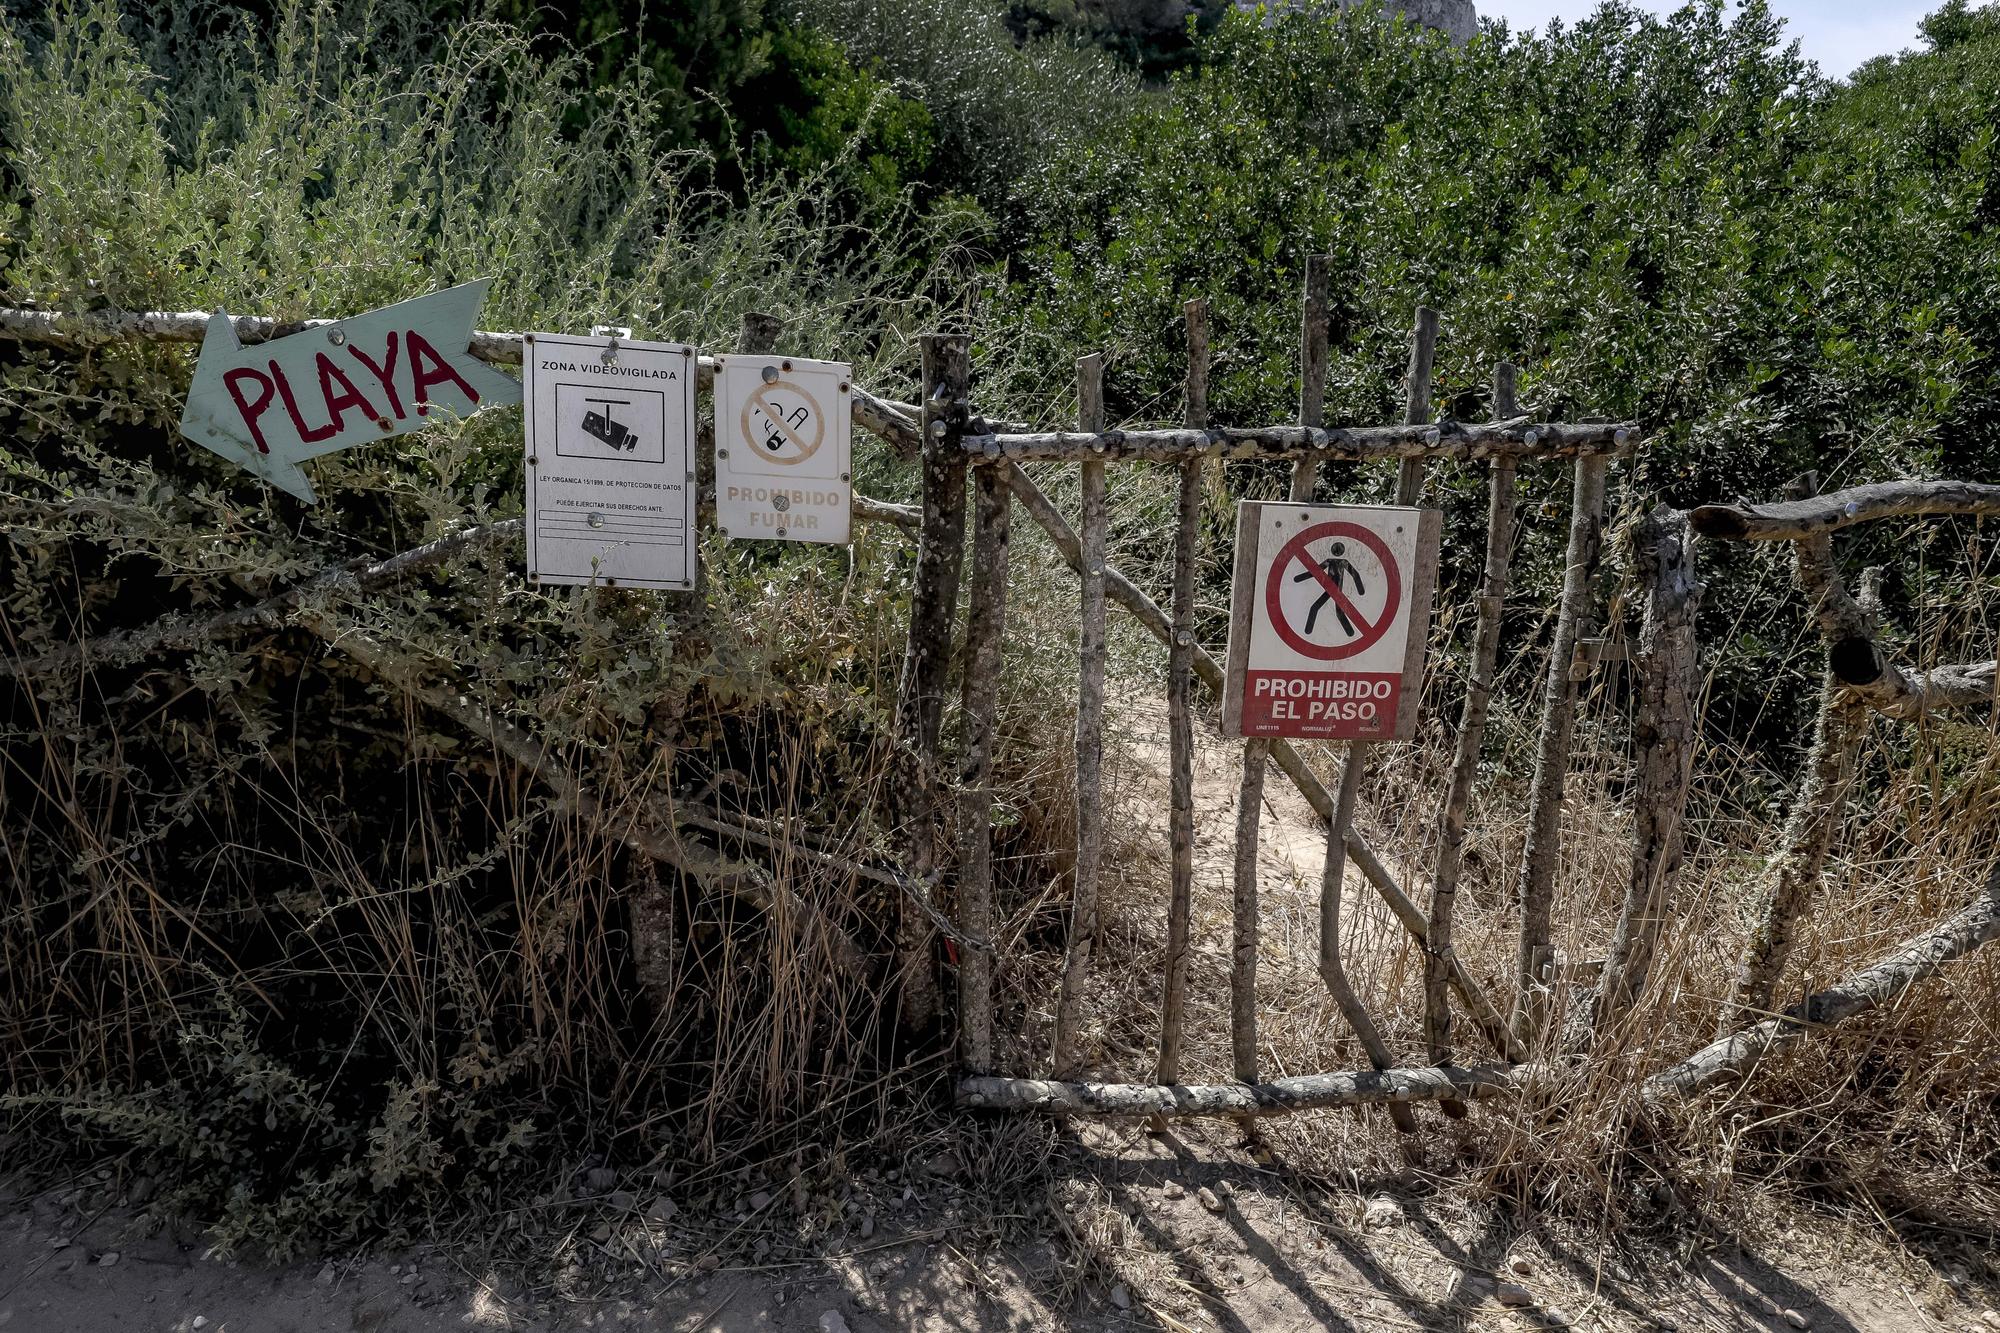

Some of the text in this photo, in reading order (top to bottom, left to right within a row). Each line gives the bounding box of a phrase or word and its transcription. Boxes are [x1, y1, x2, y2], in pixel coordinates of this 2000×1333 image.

[541, 361, 677, 381] ZONA VIDEOVIGILADA
[223, 329, 480, 454] PLAYA
[615, 480, 653, 489] PROTECCION
[556, 499, 575, 507] PUEDE
[575, 500, 605, 509] EJERCITAR
[617, 503, 648, 512] DERECHOS
[727, 486, 840, 507] PROHIBIDO
[749, 511, 819, 529] FUMAR
[1254, 678, 1392, 699] PROHIBIDO
[1271, 700, 1376, 721] EL PASO
